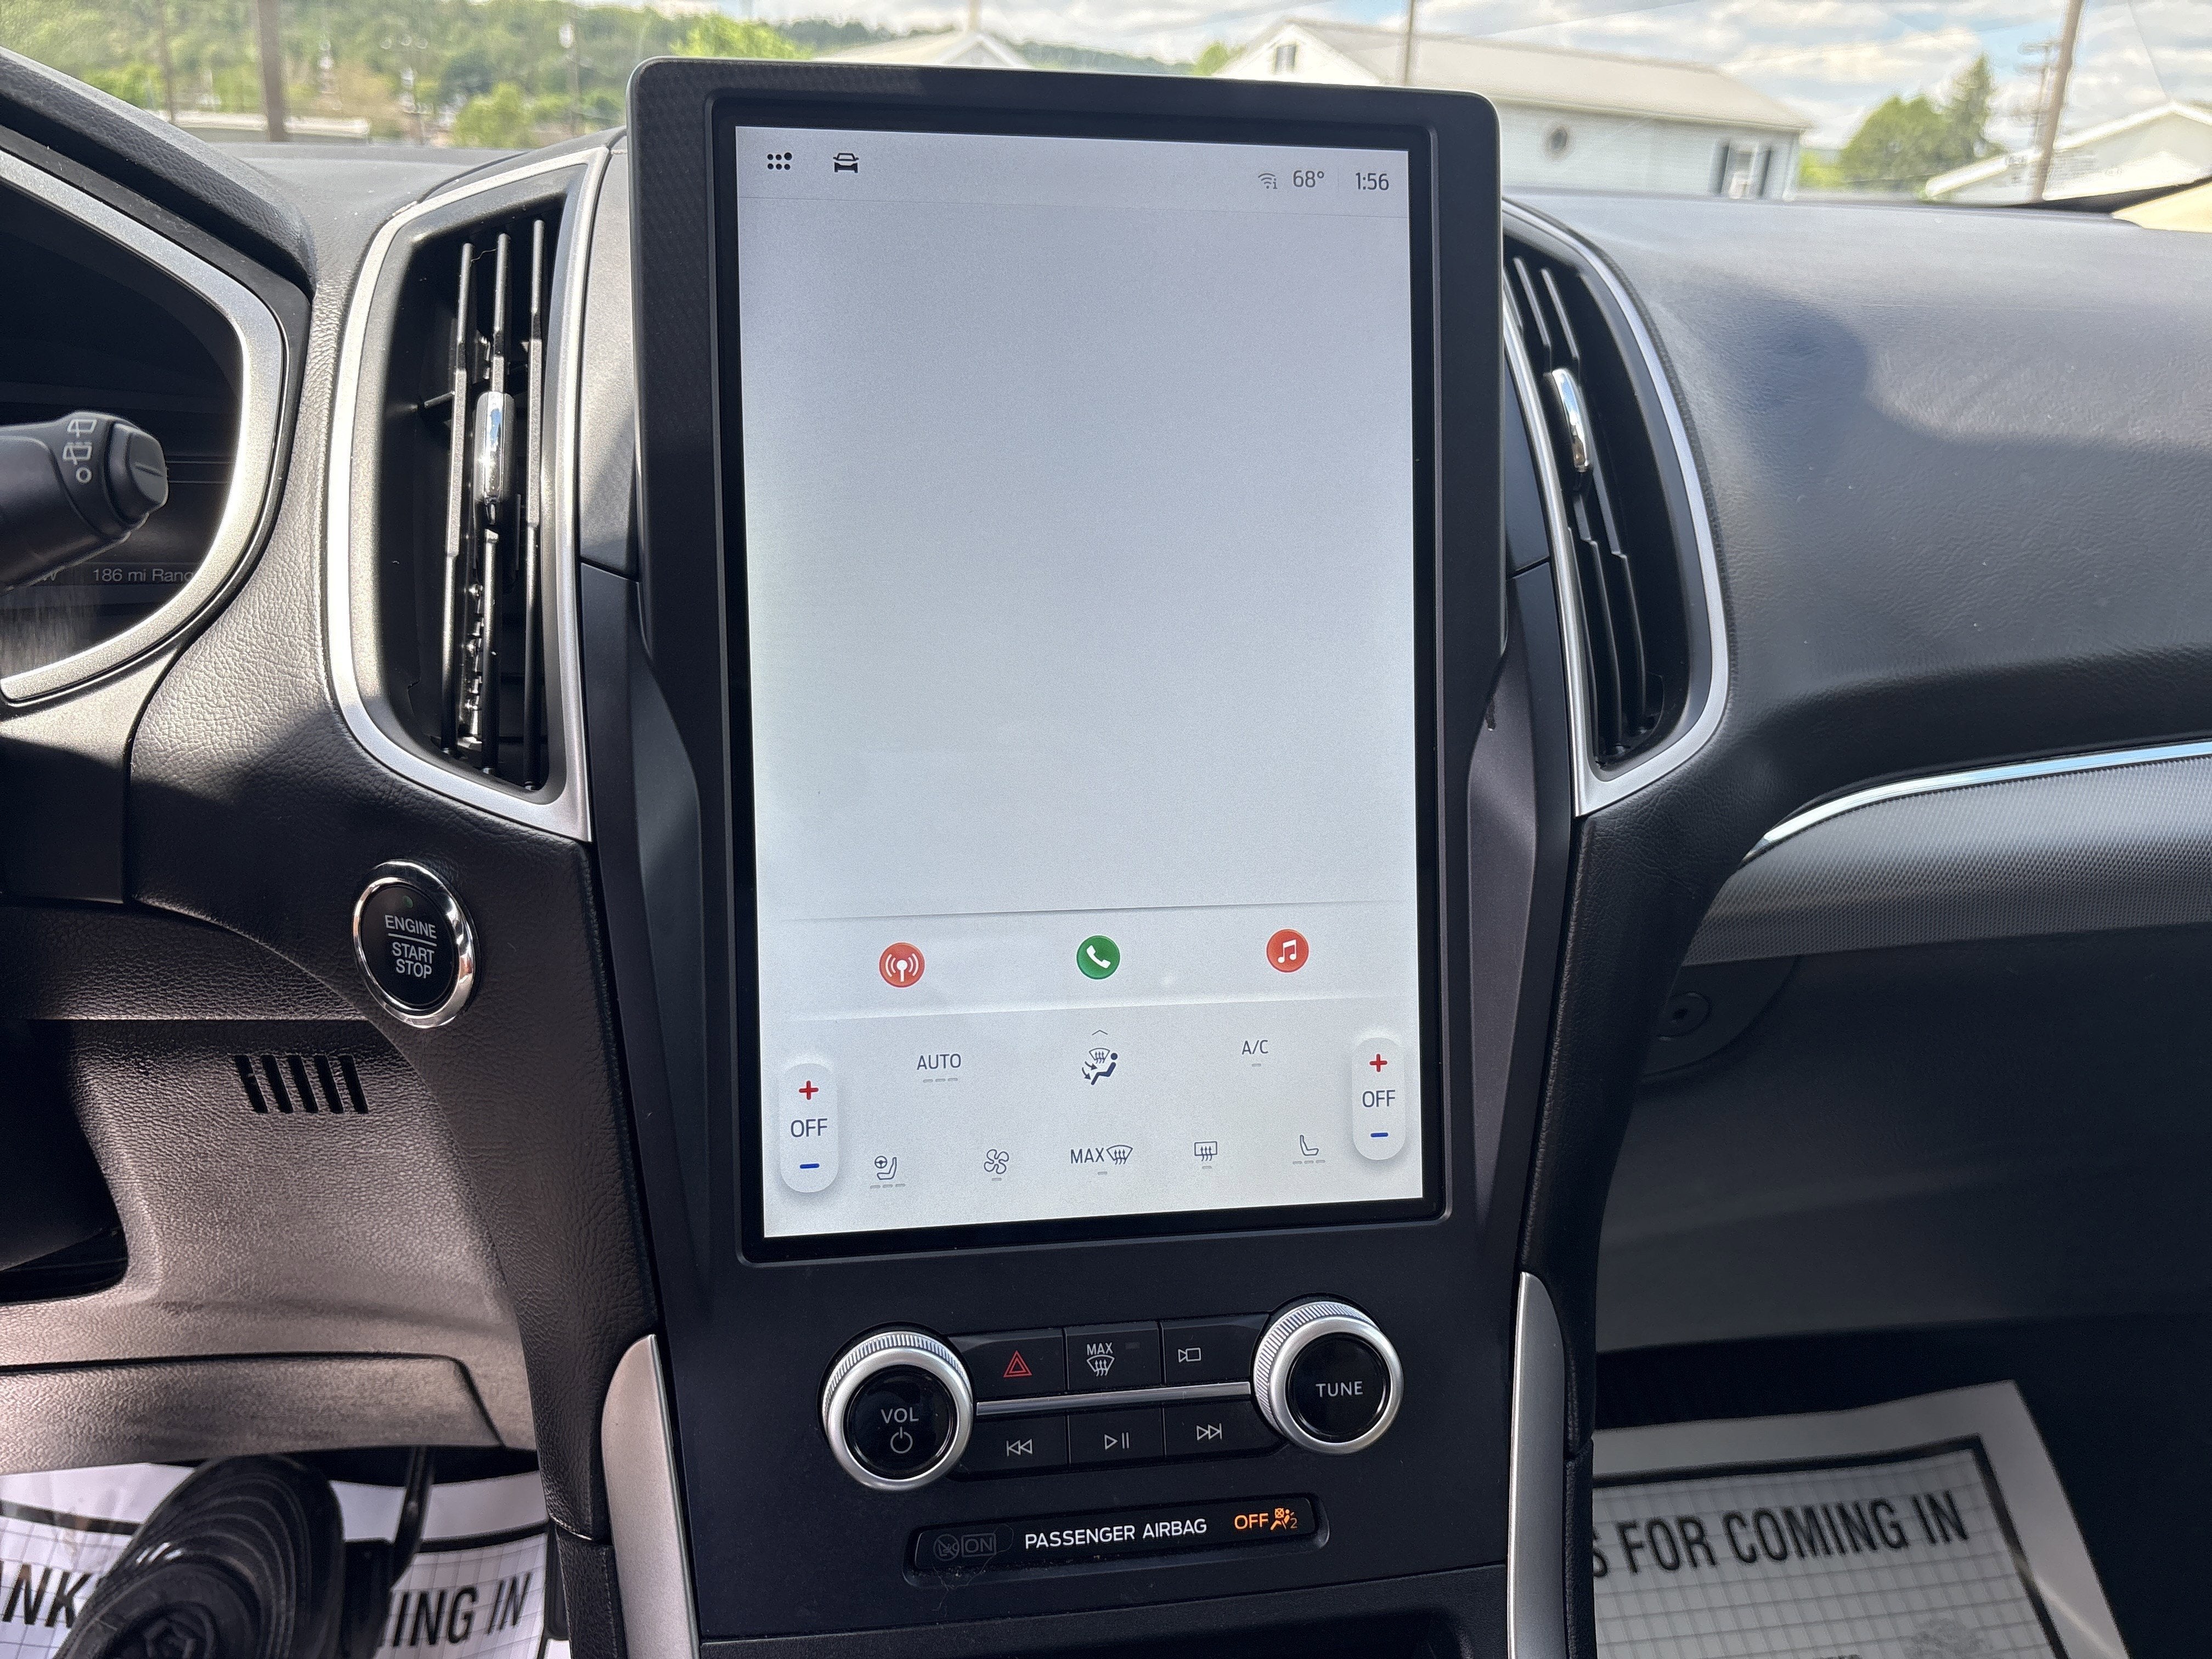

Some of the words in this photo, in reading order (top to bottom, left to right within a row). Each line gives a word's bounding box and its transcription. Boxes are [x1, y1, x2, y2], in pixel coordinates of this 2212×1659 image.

[1293, 170, 1324, 188] 68°
[1355, 172, 1390, 191] 1:56
[93, 568, 123, 582] 186
[128, 568, 146, 582] mi
[385, 915, 437, 939] ENGINE
[392, 941, 435, 964] START
[396, 958, 432, 979] STOP
[1242, 1040, 1269, 1055] A/C
[916, 1053, 961, 1070] AUTO
[1362, 1089, 1396, 1108] OFF
[791, 1118, 828, 1137] OFF
[1070, 1147, 1104, 1164] MAX
[1086, 1342, 1114, 1356] MAX
[1315, 1381, 1363, 1397] TUNE
[881, 1407, 919, 1424] VOL
[1234, 1513, 1269, 1530] OFF
[1025, 1524, 1136, 1549] PASSENGER
[1142, 1518, 1207, 1539] AIRBAG
[1615, 1514, 1718, 1575] FOR
[1721, 1497, 1911, 1564] COMING
[1911, 1489, 1970, 1547] IN
[964, 1537, 993, 1554] ON
[484, 1571, 534, 1636] IN
